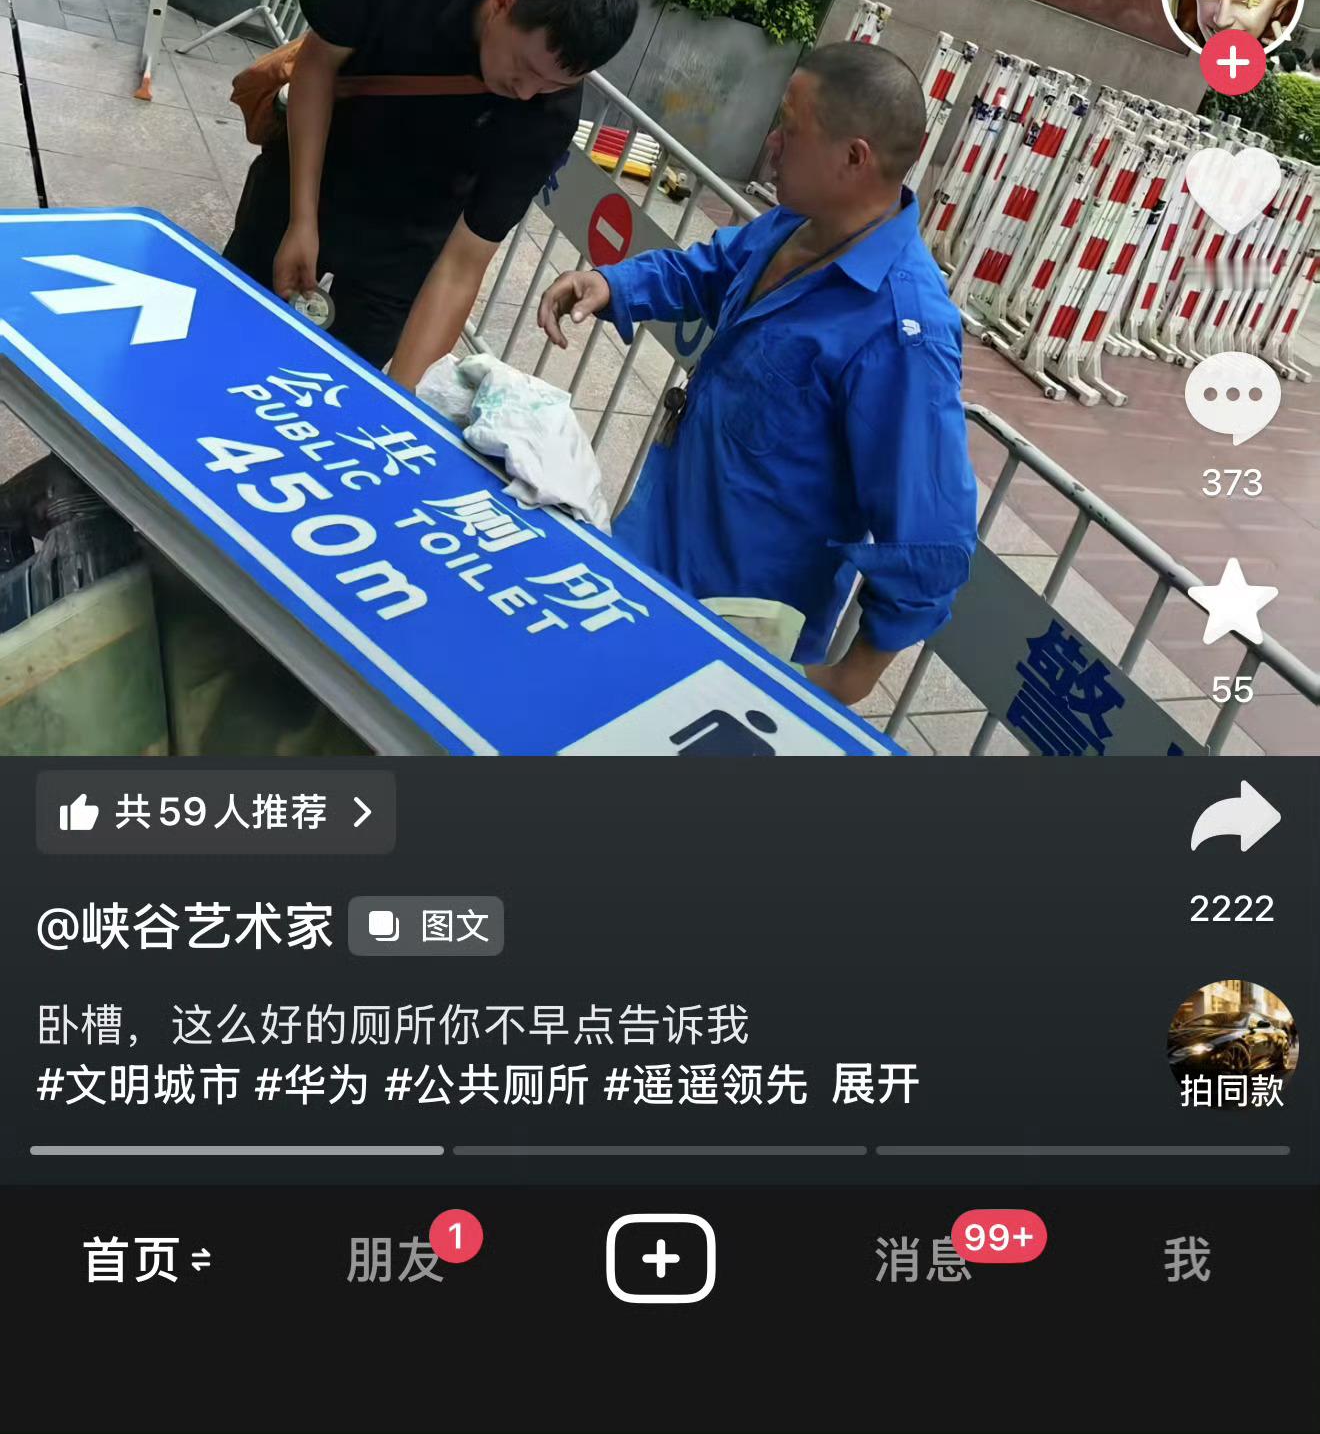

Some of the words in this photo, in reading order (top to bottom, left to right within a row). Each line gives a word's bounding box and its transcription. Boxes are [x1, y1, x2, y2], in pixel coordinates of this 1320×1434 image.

[196, 435, 429, 621] 450m
[226, 383, 382, 491] PUBLIC
[393, 507, 570, 634] TOILET
[265, 366, 650, 633] 公共厕所
